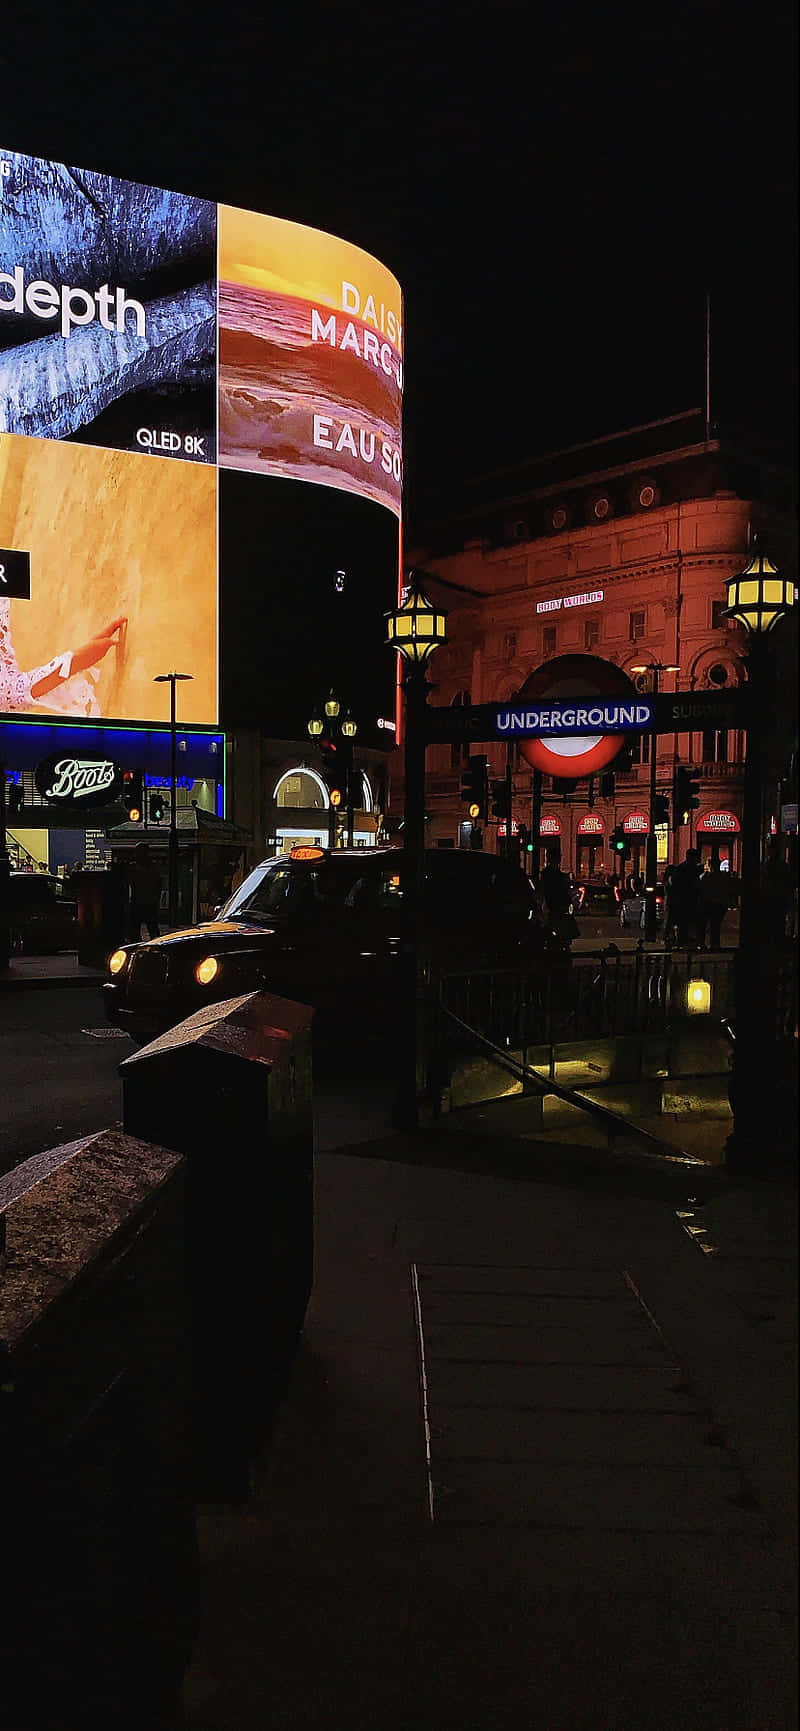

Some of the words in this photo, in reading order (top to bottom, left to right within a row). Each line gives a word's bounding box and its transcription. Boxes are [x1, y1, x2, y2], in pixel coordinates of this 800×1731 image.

[0, 265, 146, 338] depth
[311, 308, 393, 376] MARC
[136, 428, 181, 451] QLED
[184, 435, 205, 456] 8K
[313, 414, 375, 463] EAU
[497, 706, 650, 730] UNDERGROUND
[45, 759, 115, 798] Boots
